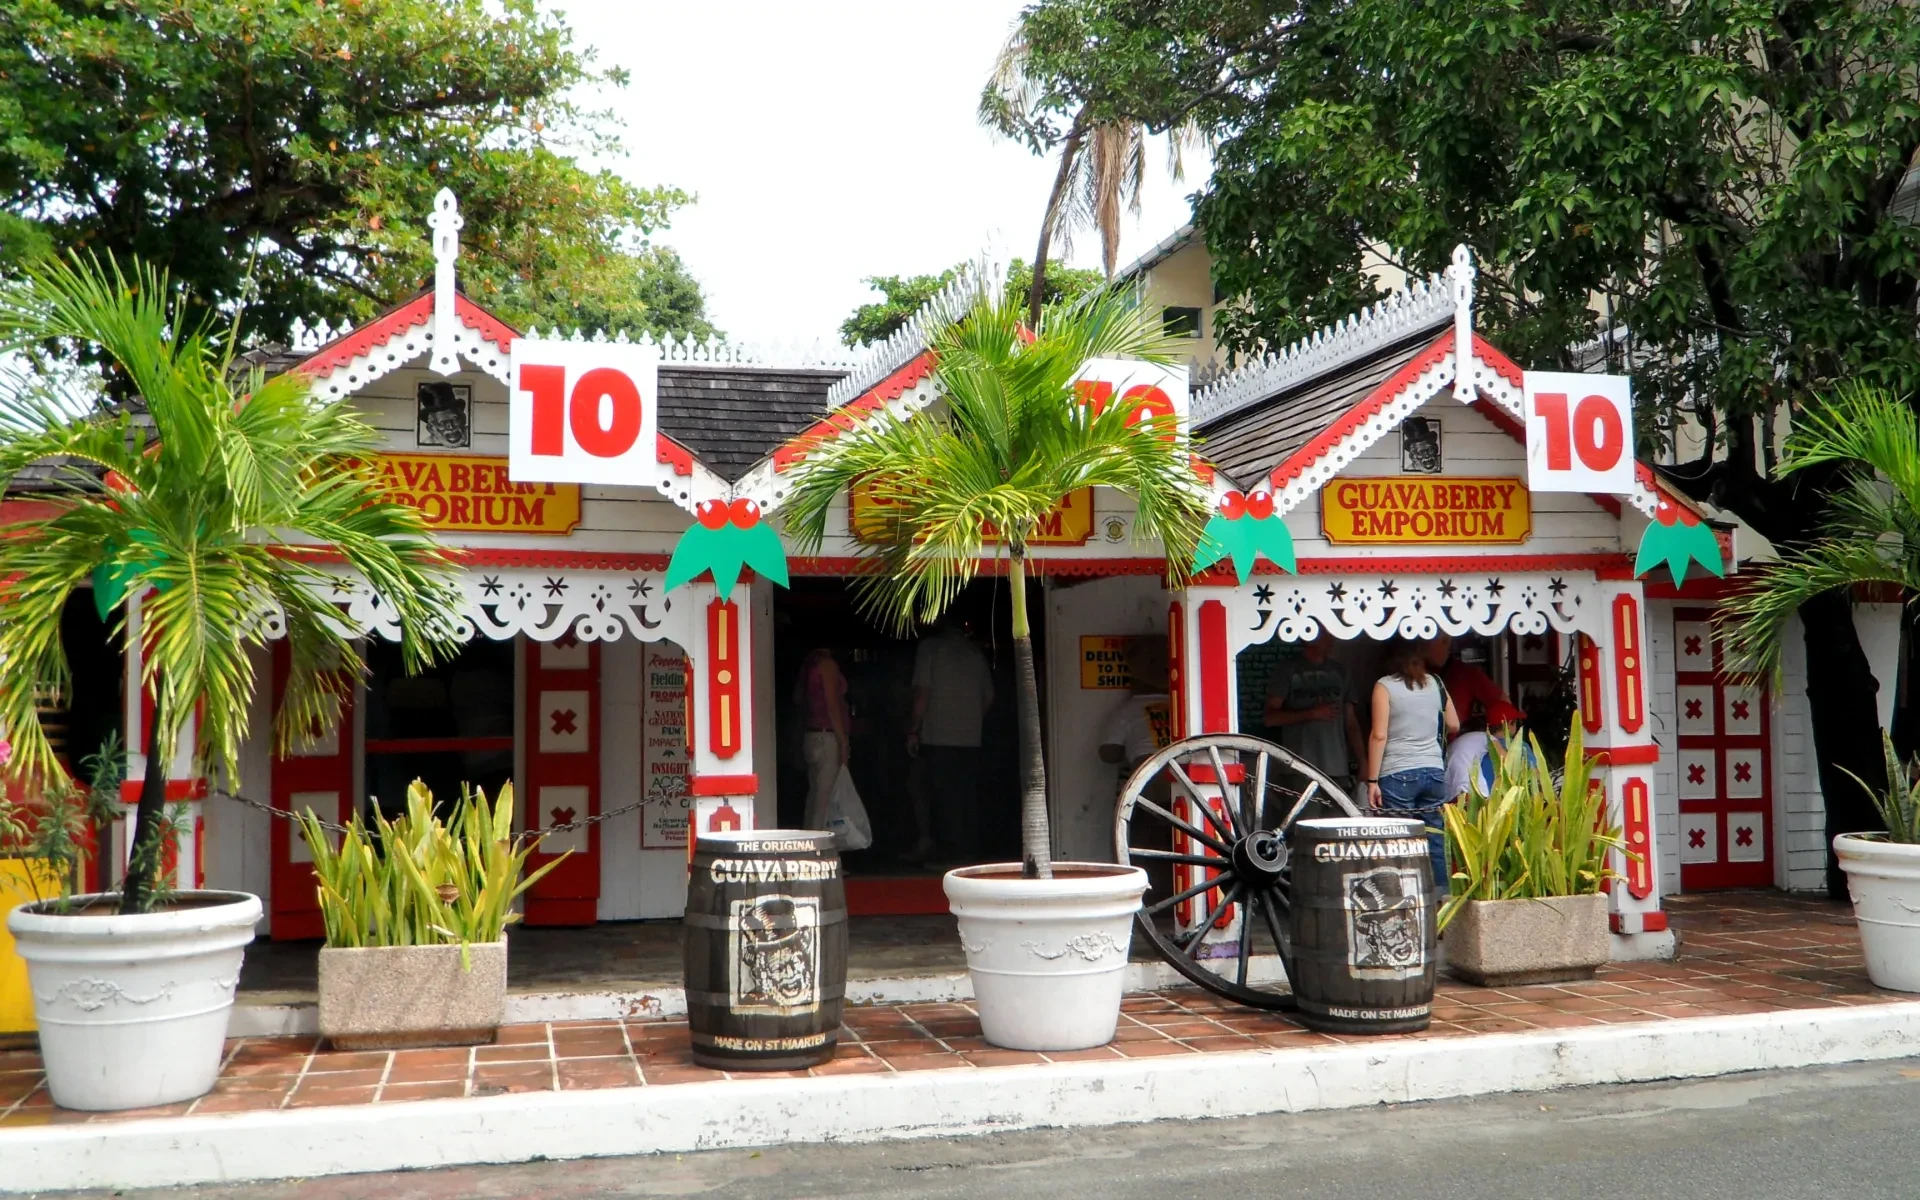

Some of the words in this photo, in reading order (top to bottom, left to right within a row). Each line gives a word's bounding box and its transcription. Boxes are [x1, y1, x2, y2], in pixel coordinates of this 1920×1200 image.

[520, 364, 642, 458] 10
[1534, 393, 1623, 472] 10
[1336, 483, 1516, 511] GUAVABERRY
[1351, 510, 1505, 537] EMPORIUM
[1086, 651, 1124, 661] DELIV
[1098, 664, 1113, 673] TO
[650, 690, 686, 699] FROMM
[648, 717, 686, 727] GEOGRA
[651, 762, 689, 775] INSIGHT
[1336, 827, 1358, 837] THE
[1360, 825, 1410, 836] ORIGINAL
[737, 841, 760, 852] THE
[762, 840, 817, 851] ORIGINAL
[1314, 839, 1429, 862] GUAVABERRY
[710, 858, 838, 884] GUAVABERRY
[1329, 1007, 1358, 1019] MADE
[1360, 1008, 1377, 1019] ON
[1378, 1007, 1392, 1020] ST
[1394, 1004, 1428, 1018] MAARTEN
[714, 1035, 743, 1049] MADE
[745, 1037, 762, 1050] ON
[765, 1036, 780, 1050] ST
[782, 1033, 826, 1050] MAARTEN
